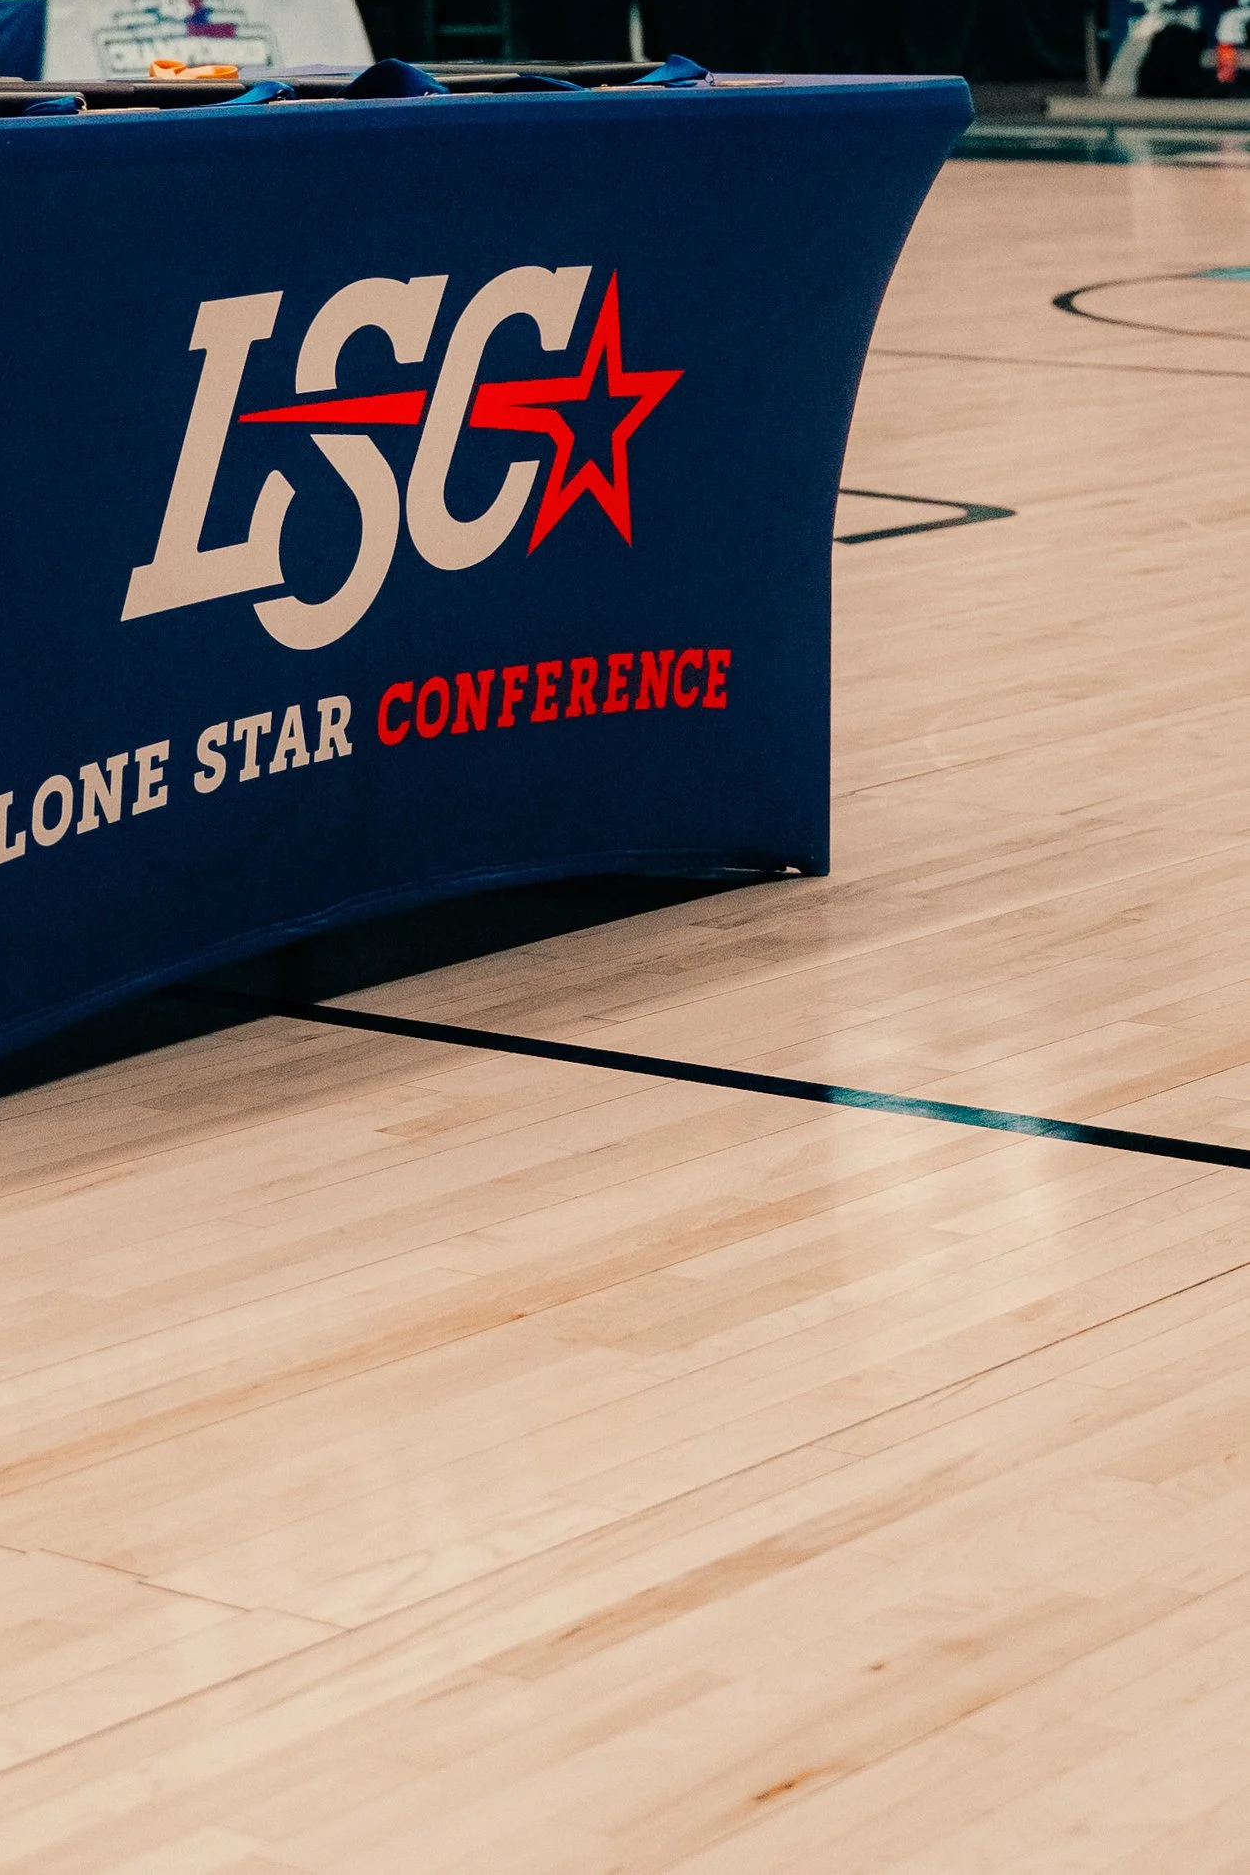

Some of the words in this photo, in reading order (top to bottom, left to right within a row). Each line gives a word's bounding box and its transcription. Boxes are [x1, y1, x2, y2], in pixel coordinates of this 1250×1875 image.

[121, 266, 592, 650] LSC
[193, 695, 353, 794] STAR
[377, 649, 732, 747] CONFERENCE
